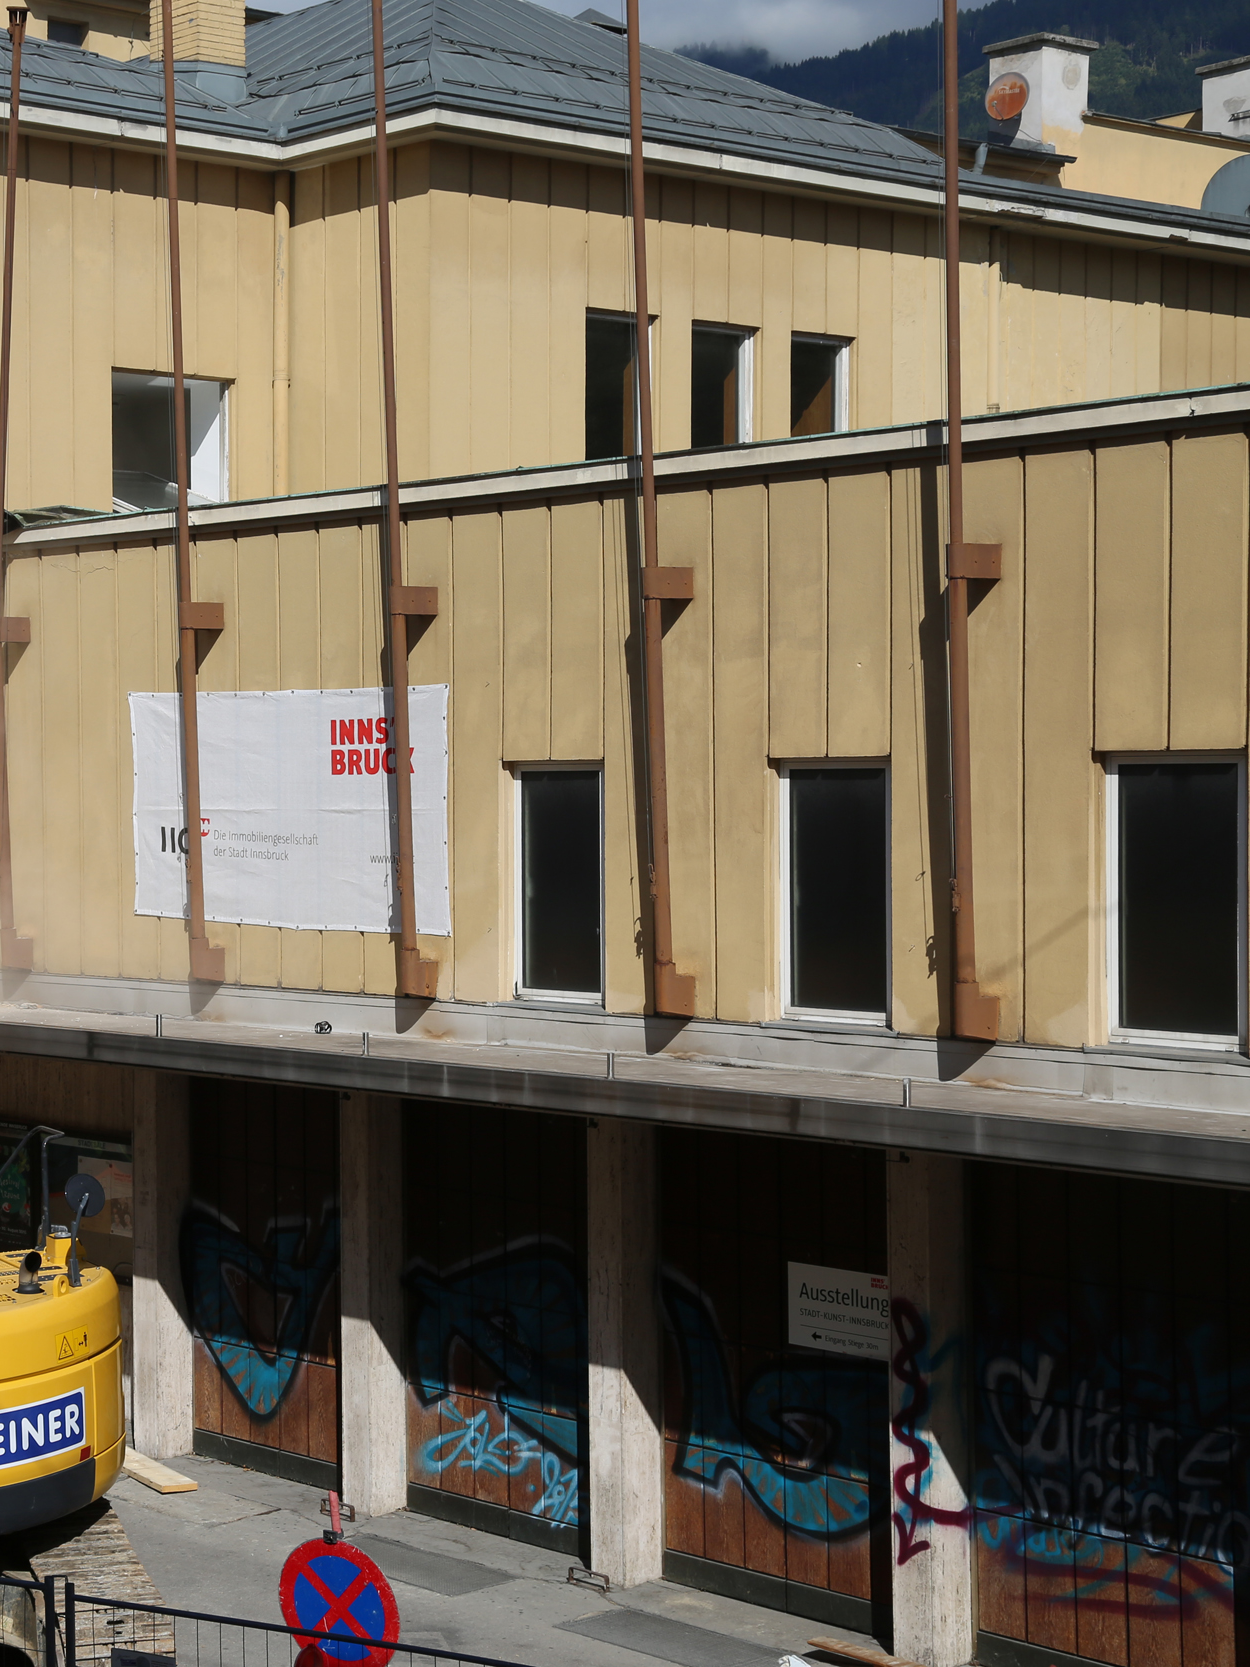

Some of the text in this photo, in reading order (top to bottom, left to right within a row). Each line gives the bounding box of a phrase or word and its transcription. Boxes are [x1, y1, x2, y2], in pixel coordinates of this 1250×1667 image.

[213, 829, 319, 847] Die Immobiliengesellschaft
[213, 846, 290, 861] der Stadt Innsbruck
[799, 1282, 889, 1318] Ausstellung
[799, 1307, 889, 1330] STADT-KUNST-INNSBRUCK
[825, 1335, 879, 1350] Eingang Stiege 30m
